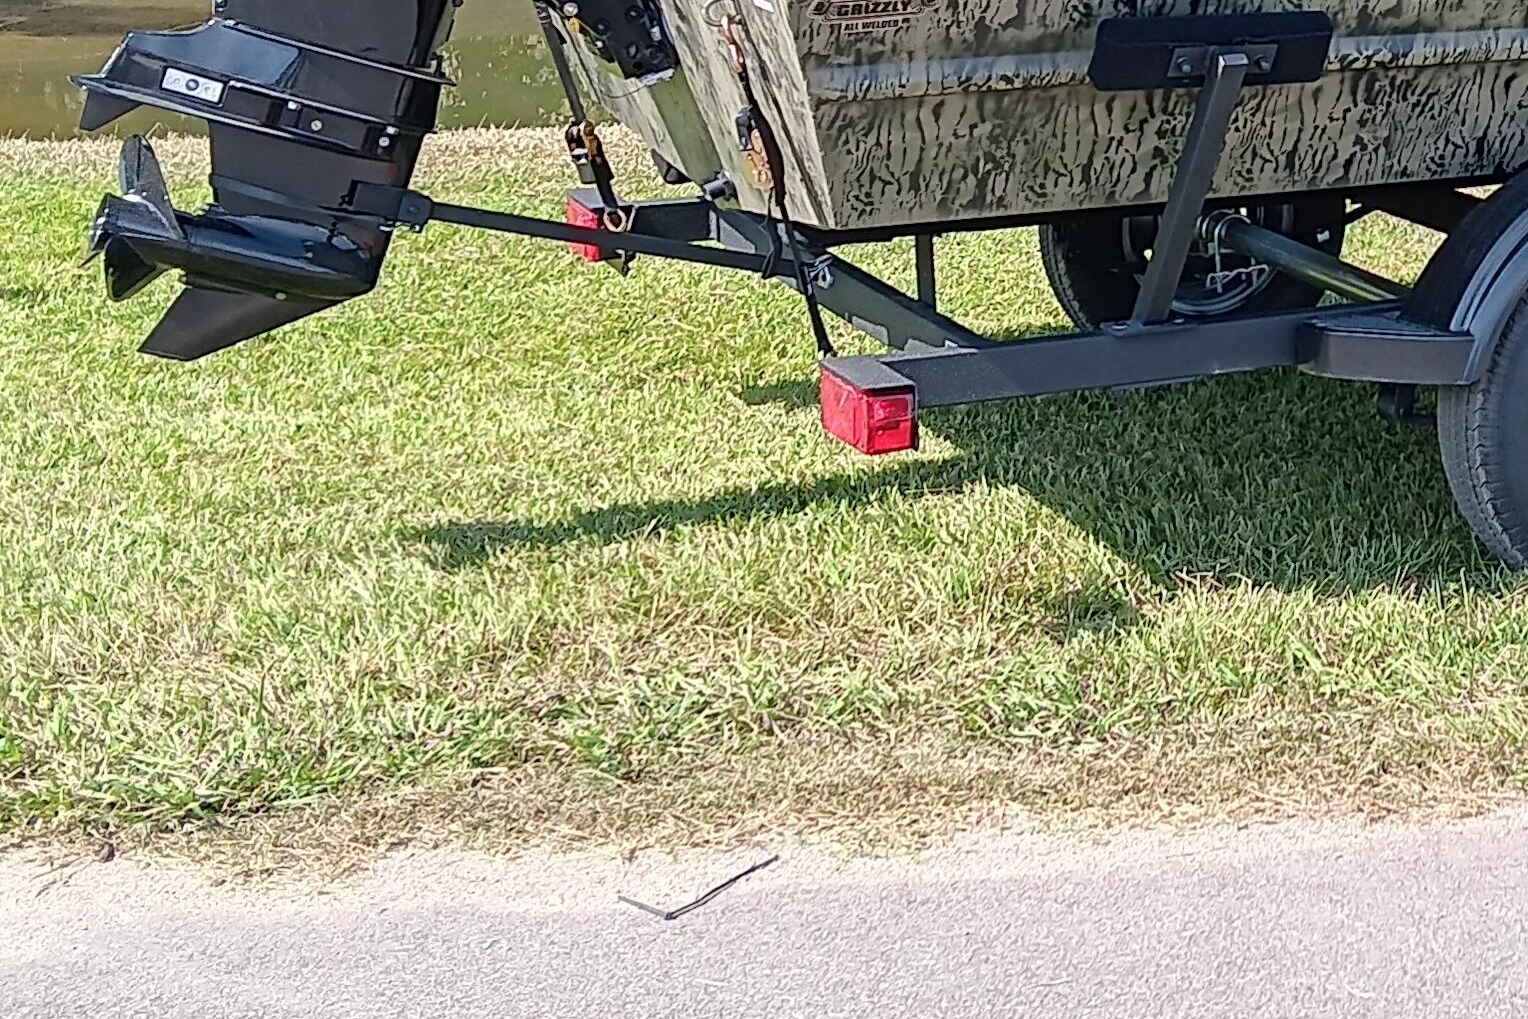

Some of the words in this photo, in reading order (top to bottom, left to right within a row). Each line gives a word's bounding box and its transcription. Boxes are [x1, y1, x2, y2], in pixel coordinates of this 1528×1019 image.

[837, 0, 911, 17] GRIZZLY
[844, 23, 859, 32] ALL
[862, 20, 899, 30] WELDED
